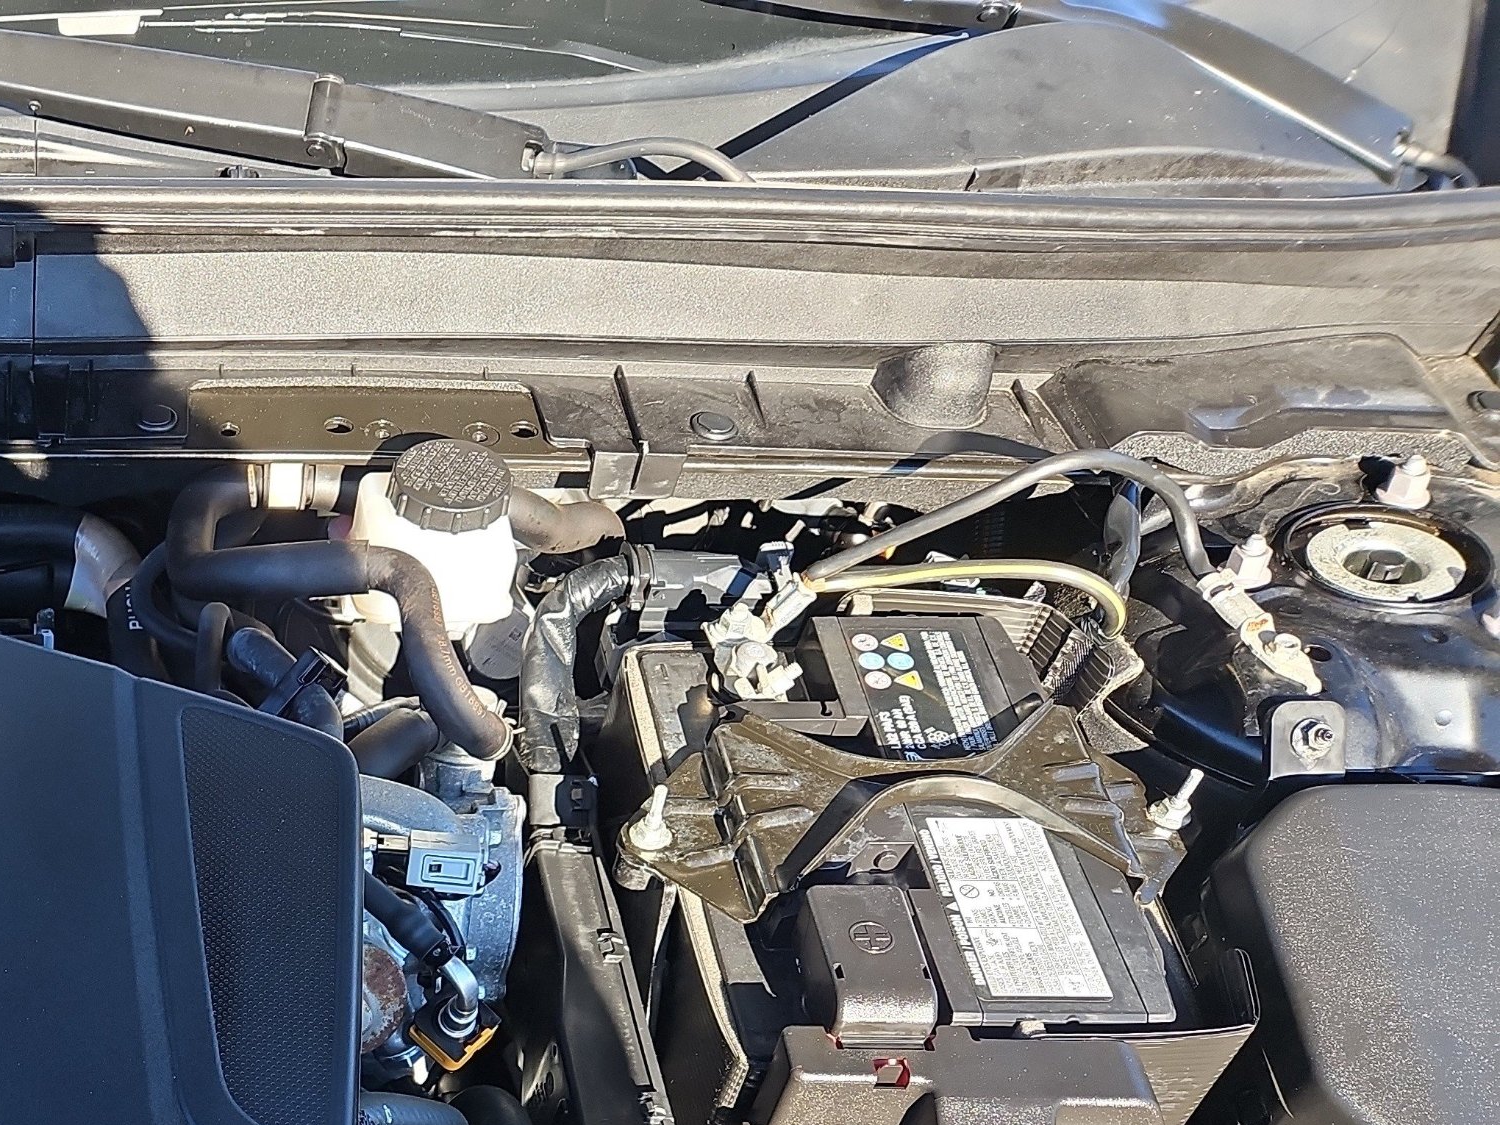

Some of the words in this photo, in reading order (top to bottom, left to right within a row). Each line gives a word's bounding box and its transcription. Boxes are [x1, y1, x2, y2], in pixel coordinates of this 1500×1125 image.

[918, 829, 939, 859] VENENO
[932, 864, 953, 898] PELIGRO
[948, 914, 971, 946] POISON
[963, 950, 986, 986] DANGER
